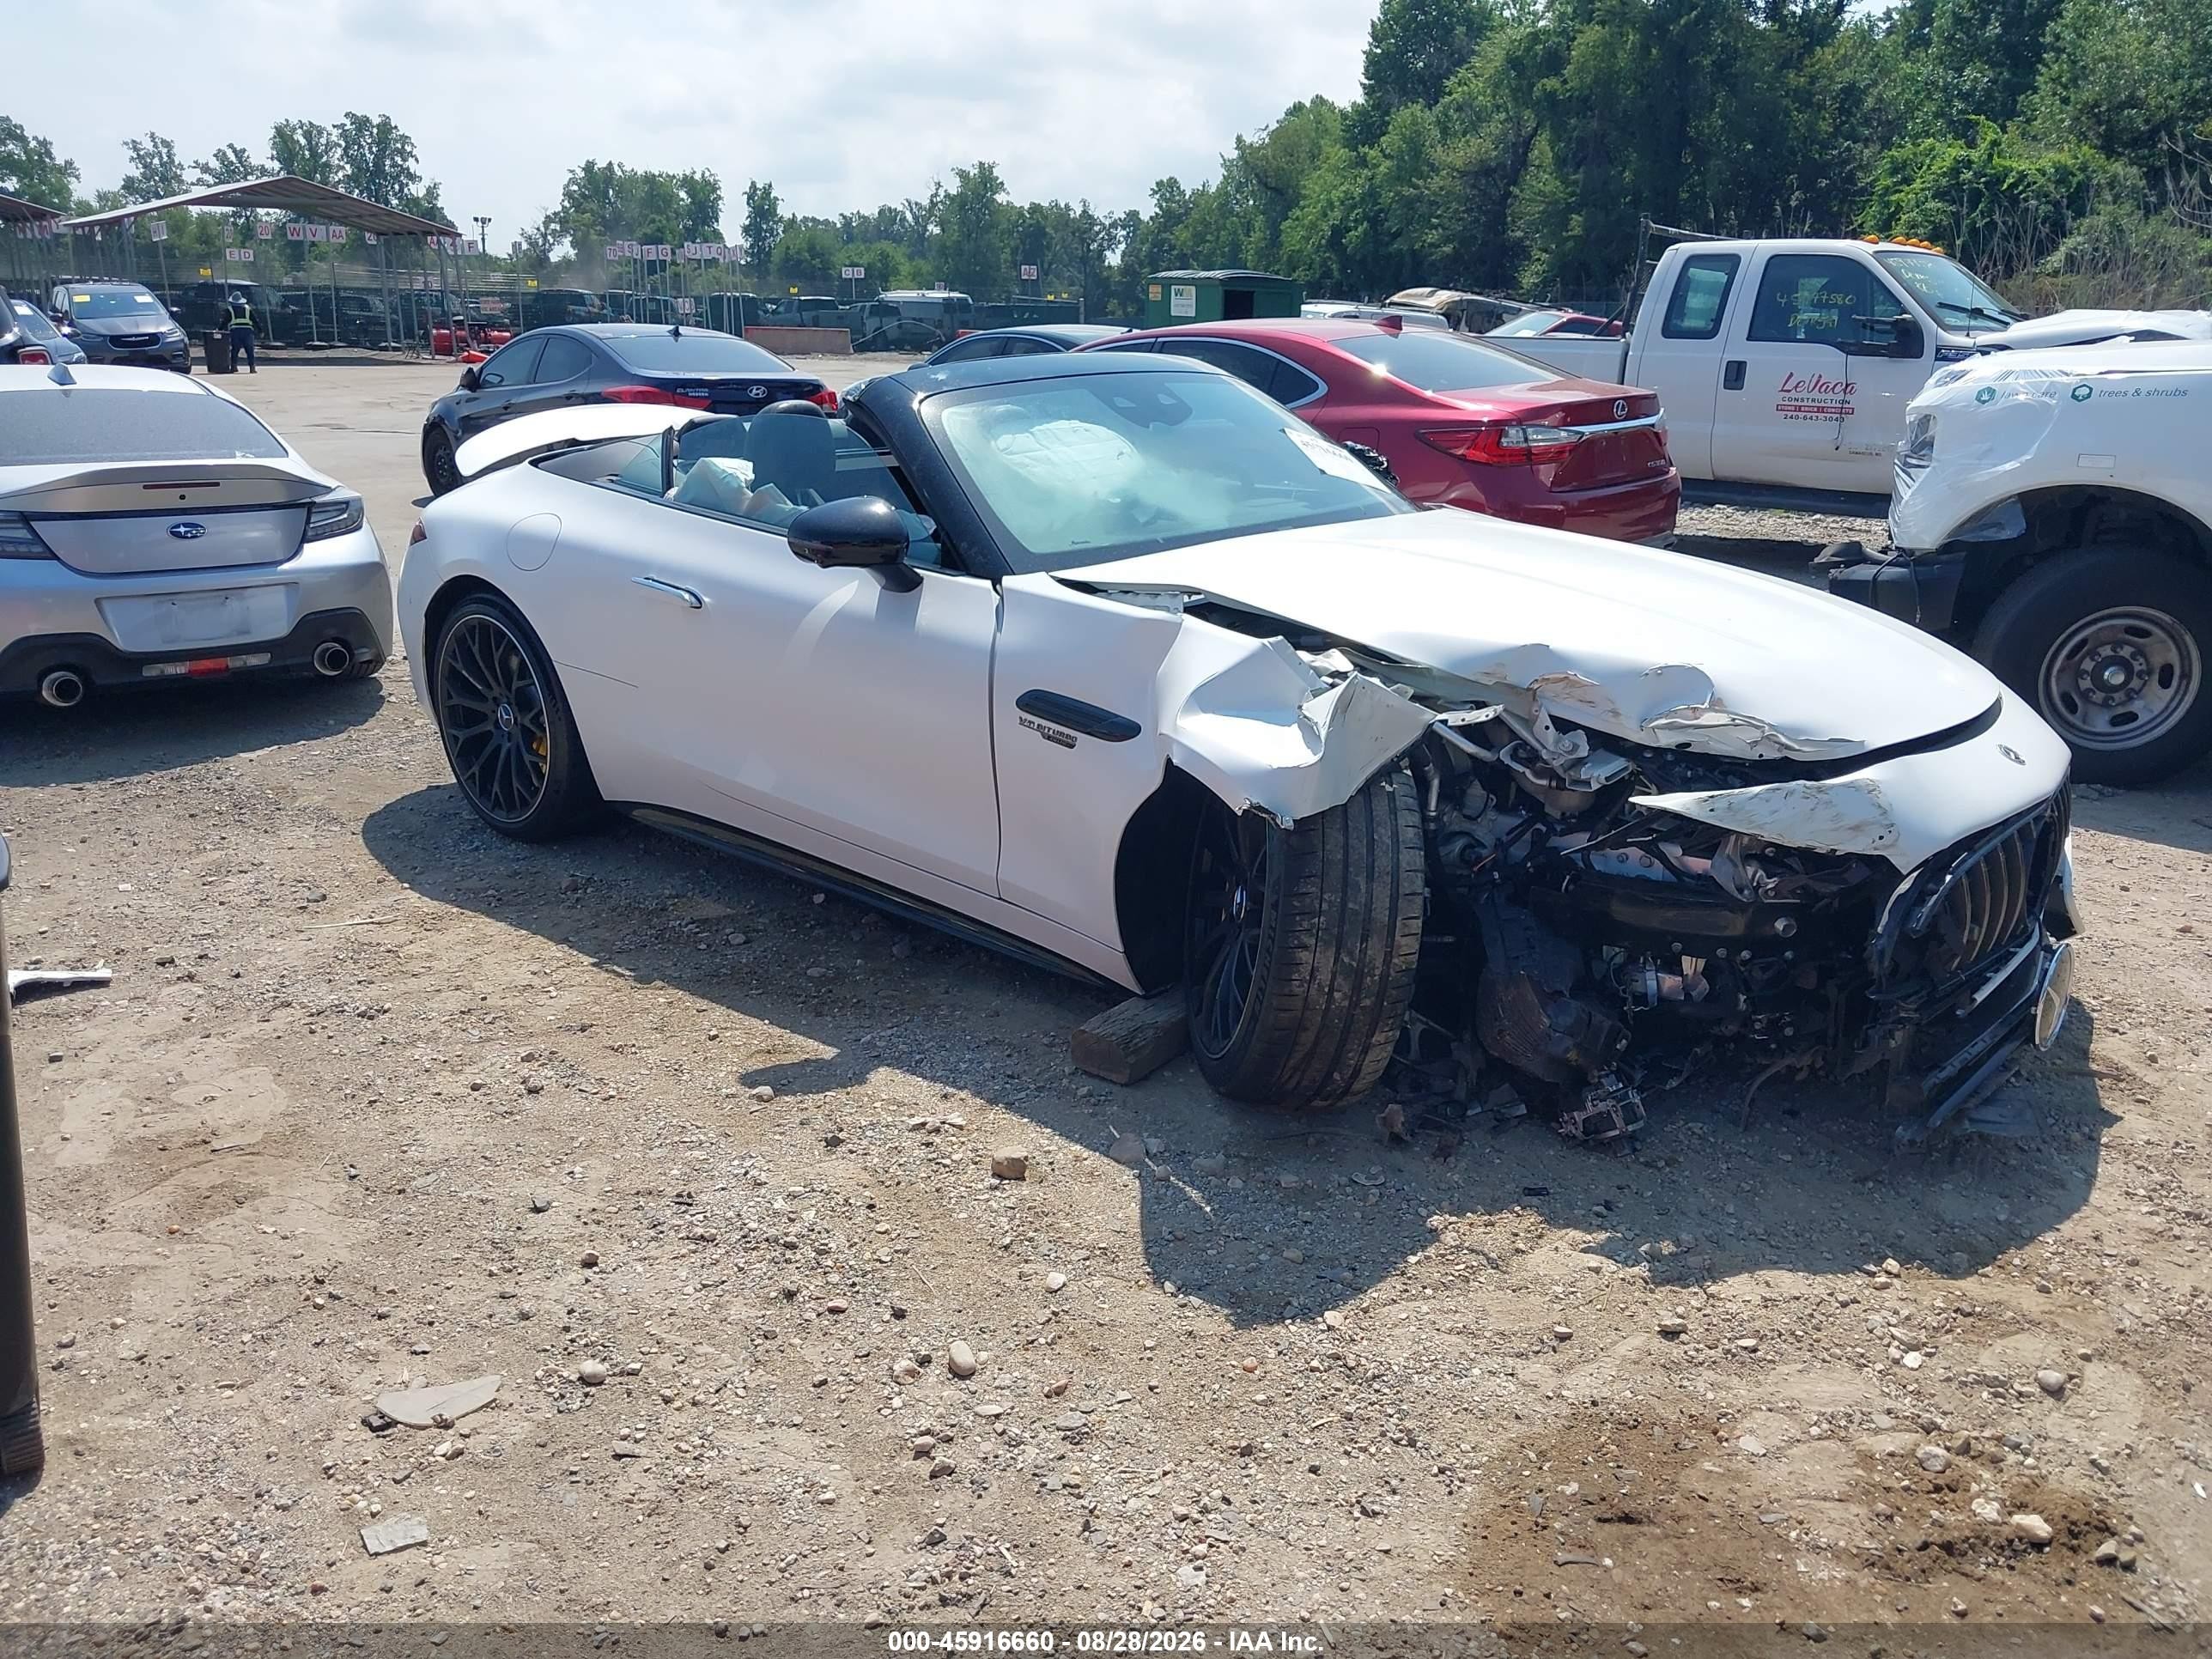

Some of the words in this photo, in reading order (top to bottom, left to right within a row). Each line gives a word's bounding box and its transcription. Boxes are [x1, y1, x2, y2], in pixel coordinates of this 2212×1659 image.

[258, 225, 270, 236] 20
[289, 226, 301, 236] W
[331, 229, 343, 240] AA
[468, 242, 475, 252] F
[608, 247, 617, 258] 70
[660, 247, 669, 257] G
[647, 249, 653, 258] F
[1778, 372, 1857, 396] LeVaca
[2099, 388, 2129, 398] trees
[2131, 387, 2142, 398] &
[2145, 386, 2189, 398] shrubs
[1782, 396, 1851, 404] CONSTRUCTION
[1036, 722, 1078, 743] BITURBO
